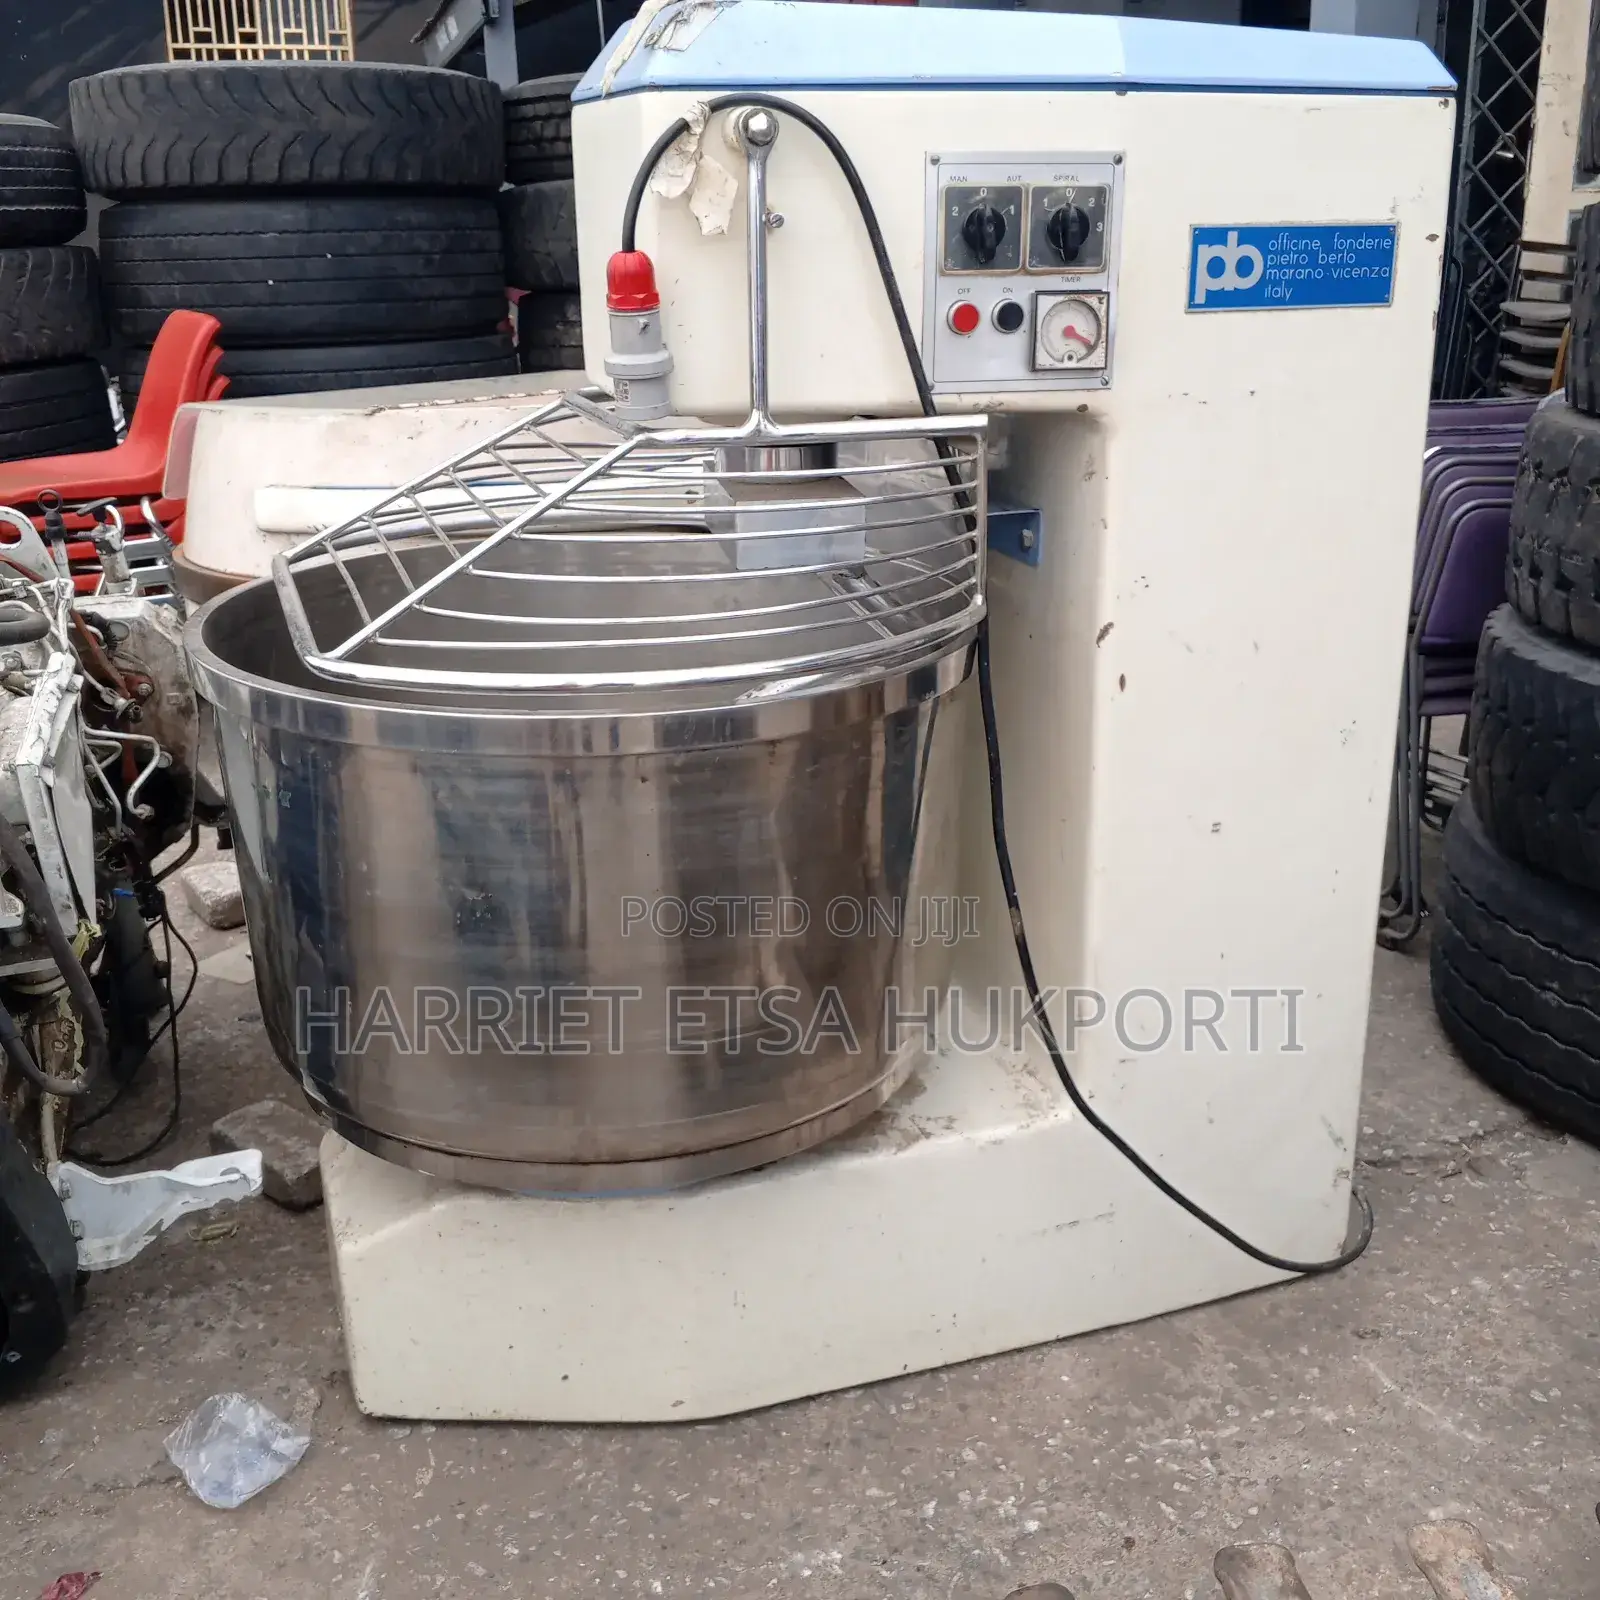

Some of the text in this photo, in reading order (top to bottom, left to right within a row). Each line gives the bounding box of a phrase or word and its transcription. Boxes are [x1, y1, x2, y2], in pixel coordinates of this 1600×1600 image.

[950, 175, 968, 183] MAN
[1053, 174, 1080, 183] SPIRAL
[980, 187, 988, 197] 0
[1065, 188, 1073, 197] 0
[1043, 196, 1049, 207] 1
[1088, 197, 1095, 207] 2
[952, 206, 959, 216] 2
[1009, 205, 1015, 215] 1
[1096, 222, 1103, 232] 3
[1268, 232, 1392, 251] officine fonderie
[1267, 248, 1356, 267] pietro berto
[957, 287, 971, 295] OFF
[1002, 286, 1013, 294] ON
[1264, 282, 1293, 301] italy
